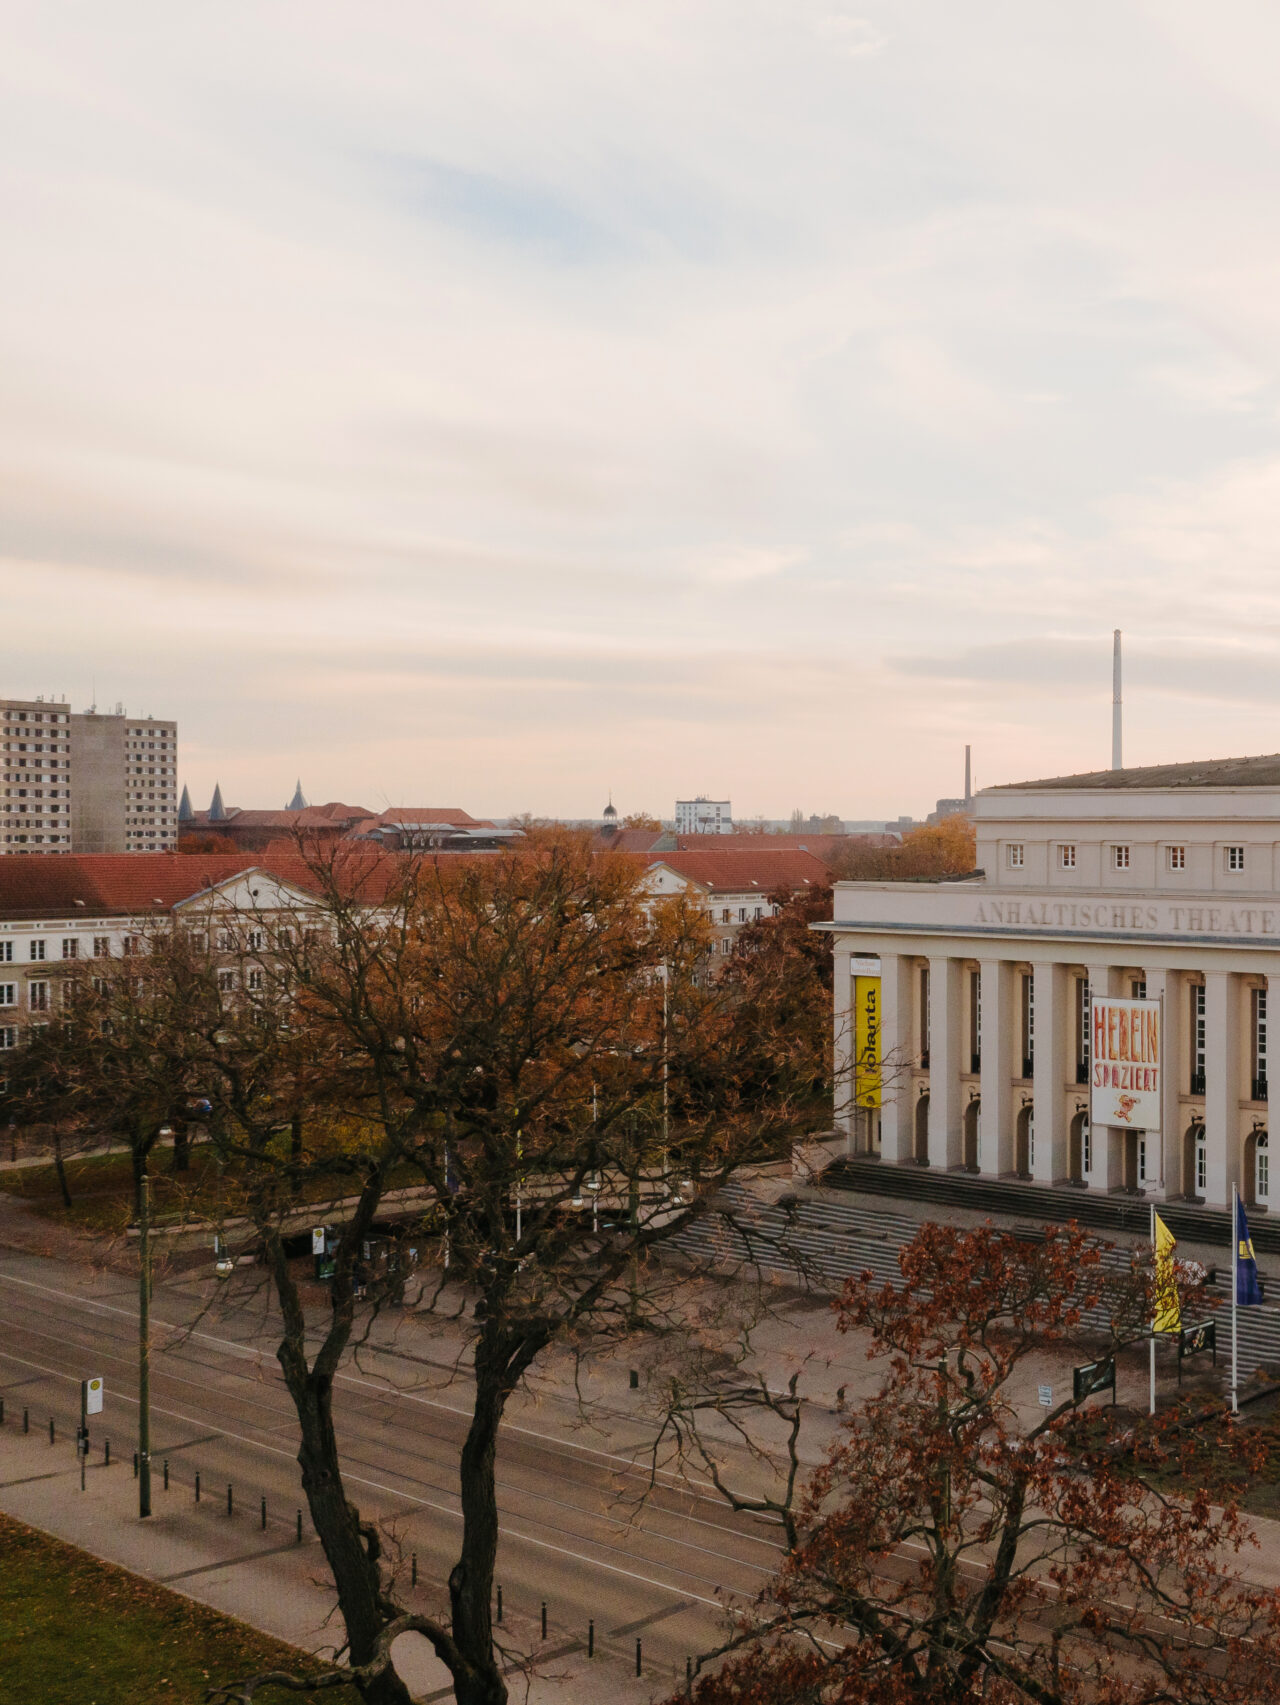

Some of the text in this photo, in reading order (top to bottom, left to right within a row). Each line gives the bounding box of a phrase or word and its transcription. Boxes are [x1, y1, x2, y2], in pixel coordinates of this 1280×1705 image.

[975, 901, 1158, 929] ANHALTISCHES
[1094, 1005, 1158, 1063] HEREIN
[1094, 1063, 1158, 1092] SPAZIERT
